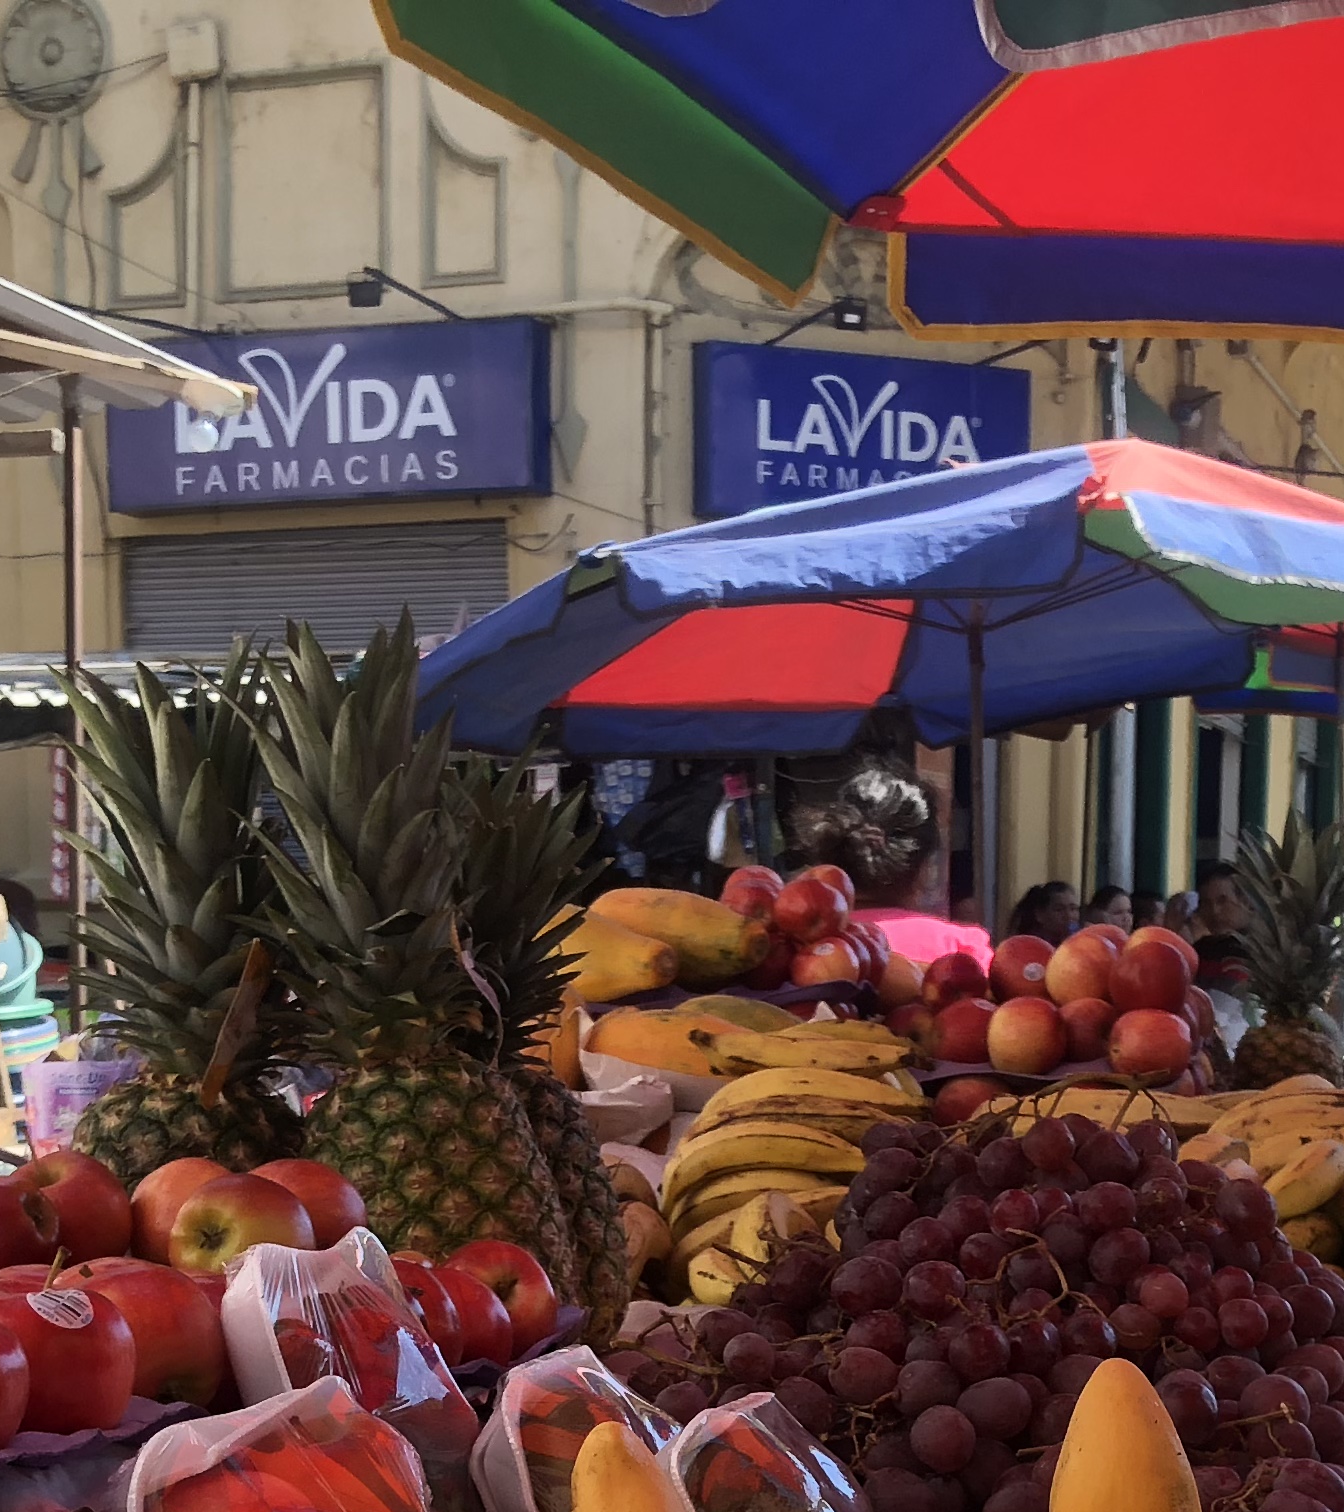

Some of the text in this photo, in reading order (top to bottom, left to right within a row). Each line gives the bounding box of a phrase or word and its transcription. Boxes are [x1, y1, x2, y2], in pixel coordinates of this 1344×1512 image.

[173, 342, 458, 454] LAVIDA
[757, 373, 981, 464] LAVIDA
[174, 450, 460, 496] FARMACIAS
